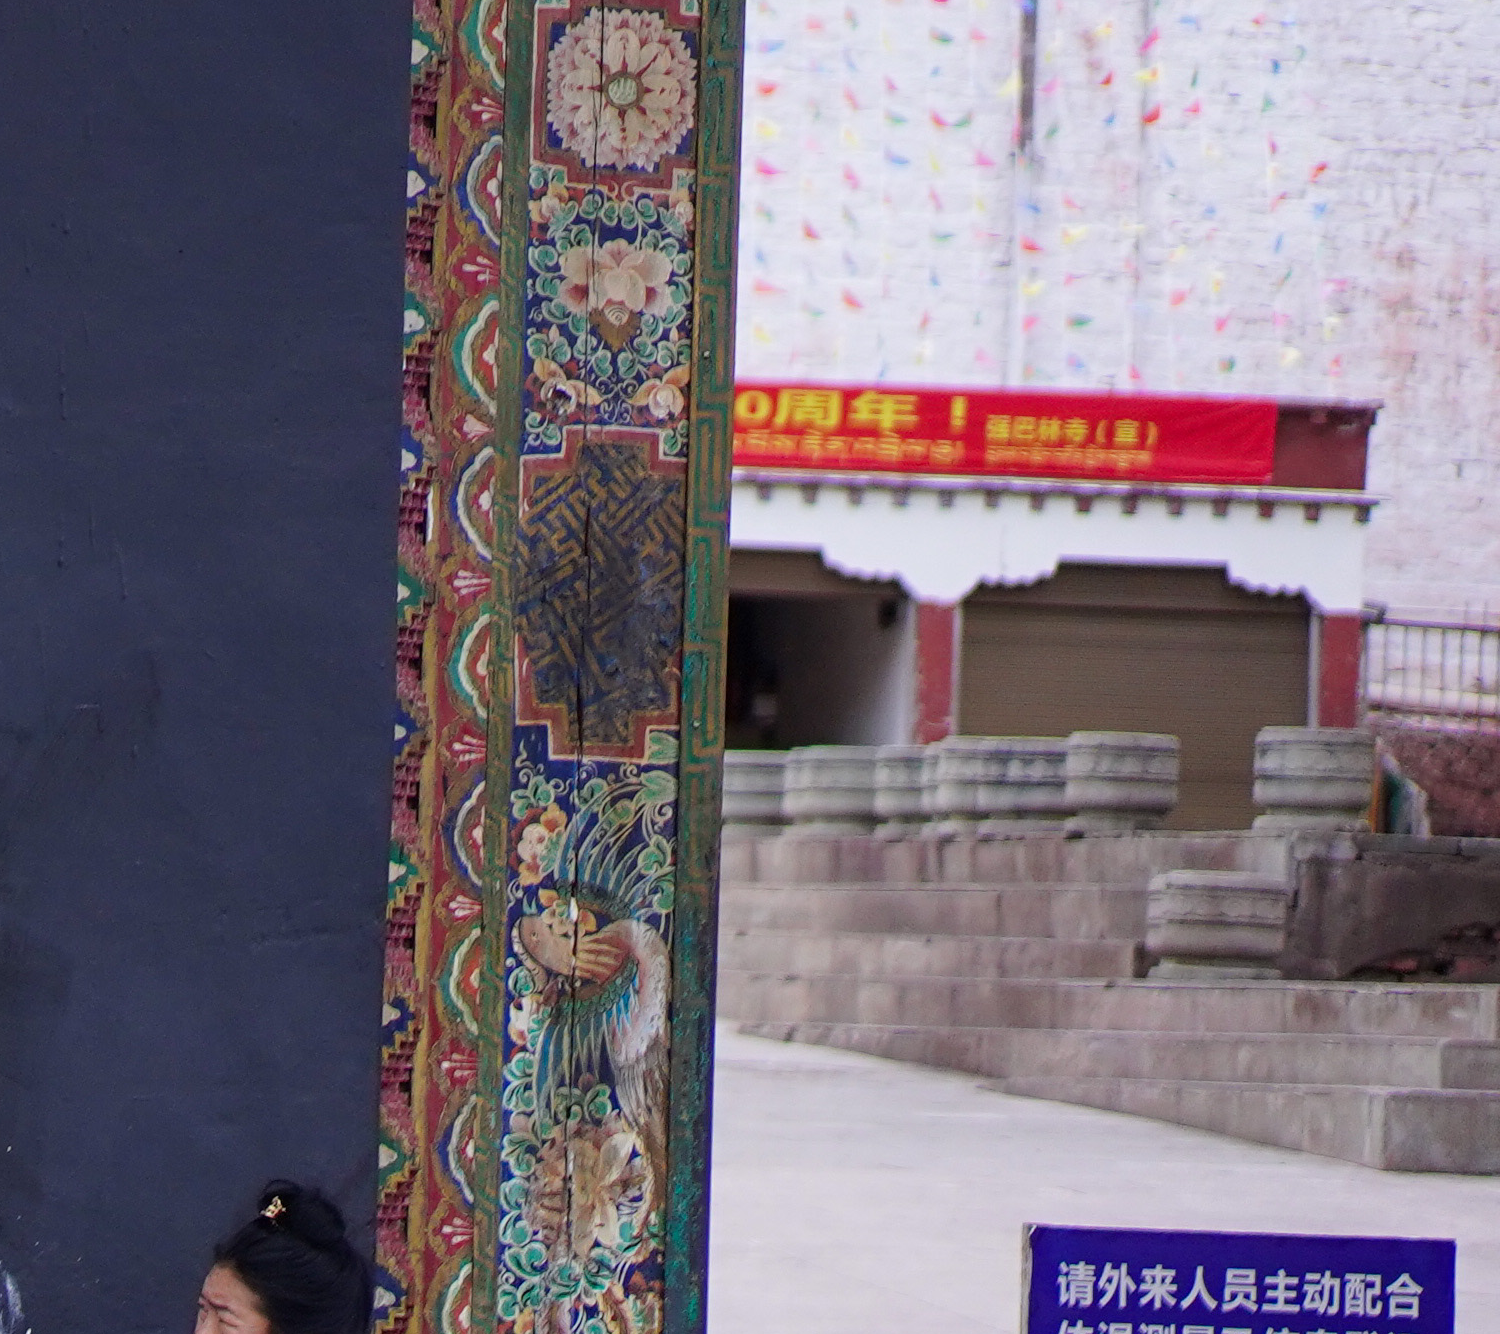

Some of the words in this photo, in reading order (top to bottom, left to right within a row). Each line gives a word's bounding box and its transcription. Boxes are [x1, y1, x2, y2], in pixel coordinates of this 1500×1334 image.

[1057, 1260, 1424, 1319] 请外来人员主动配合
